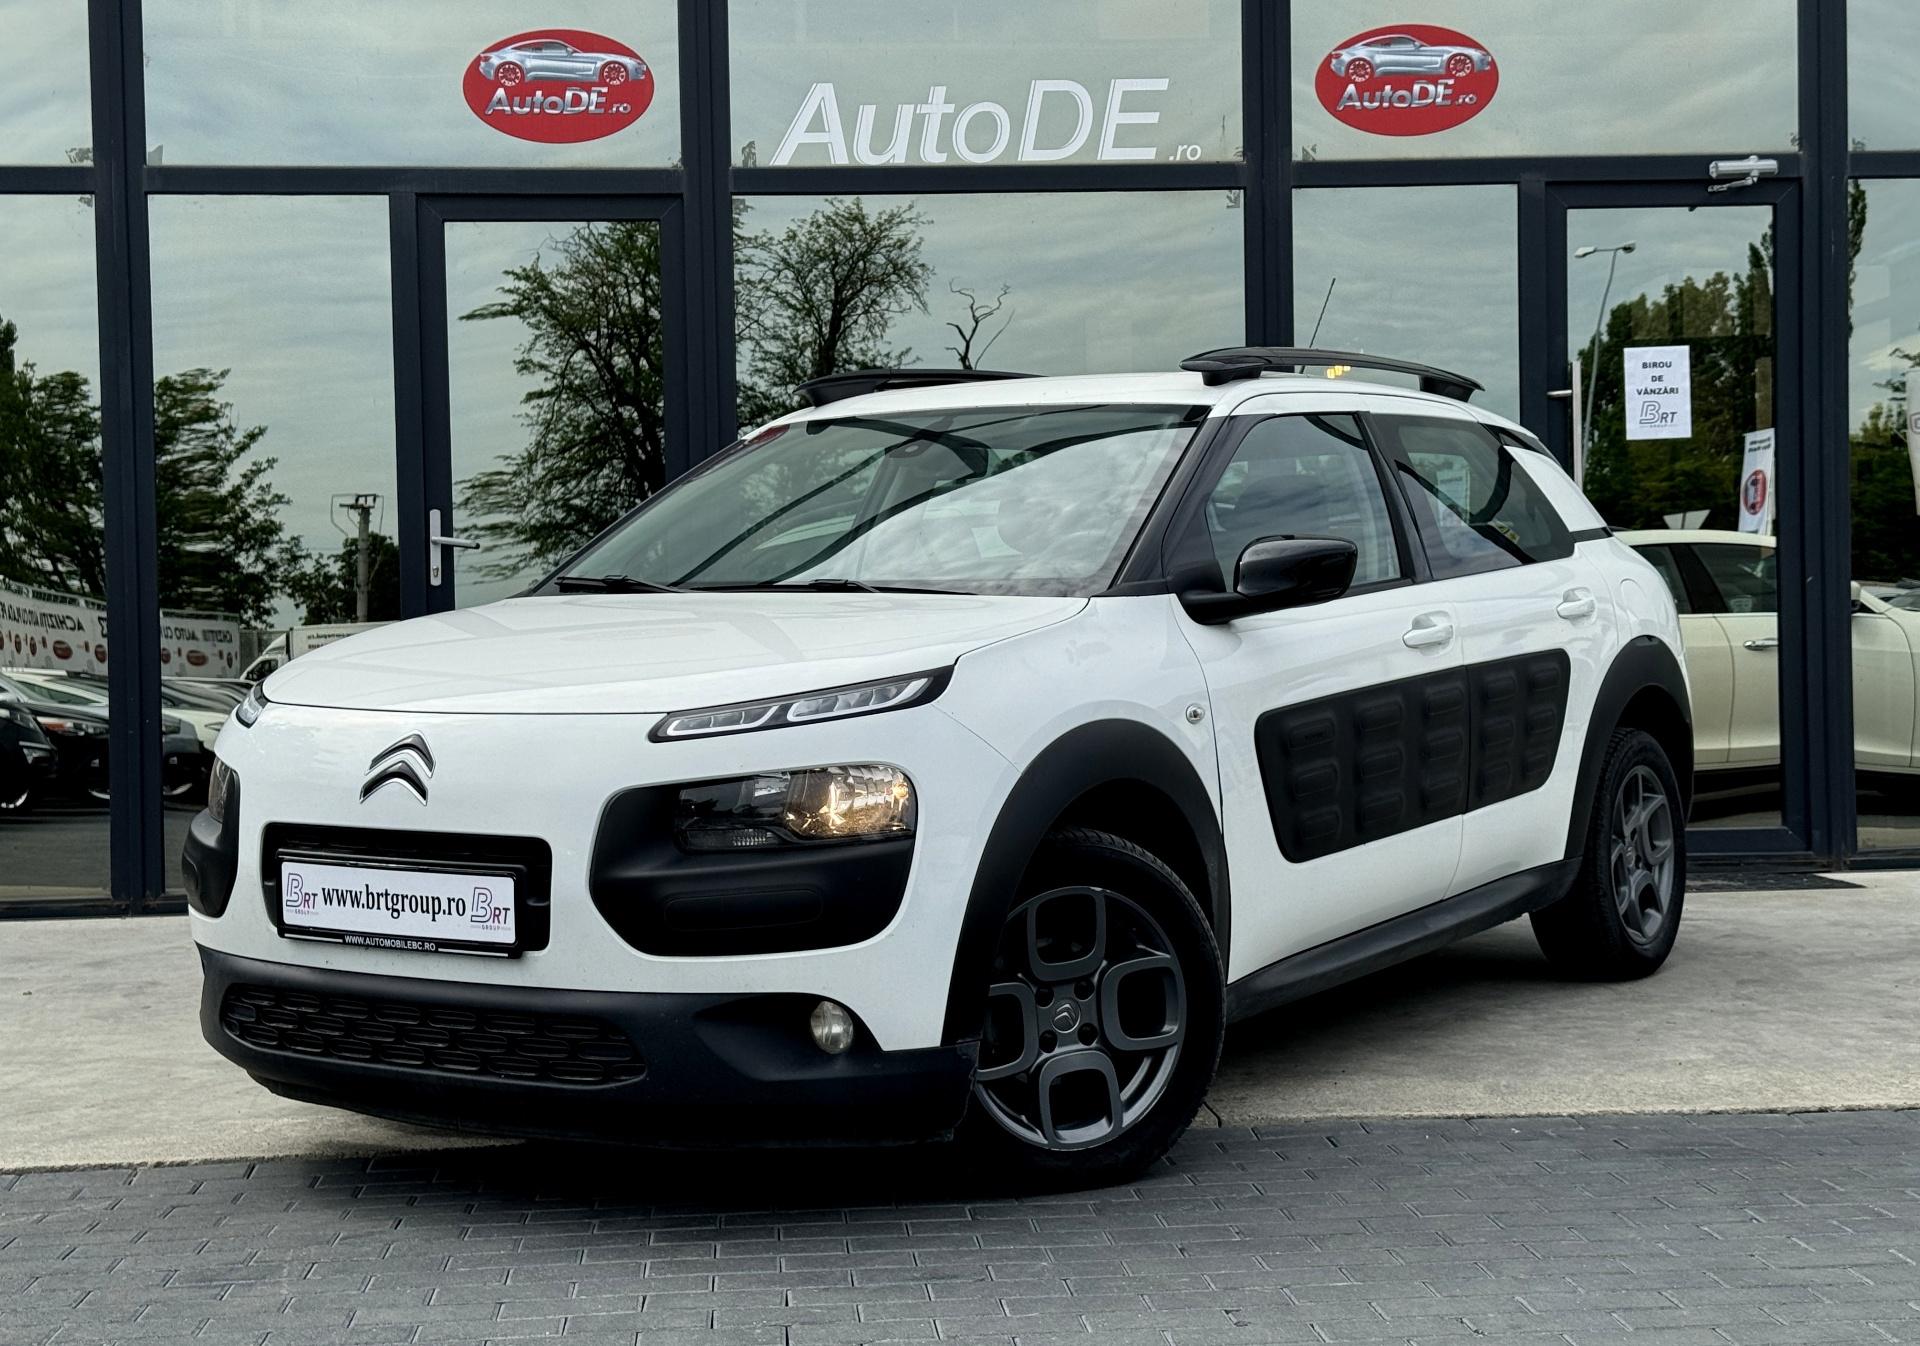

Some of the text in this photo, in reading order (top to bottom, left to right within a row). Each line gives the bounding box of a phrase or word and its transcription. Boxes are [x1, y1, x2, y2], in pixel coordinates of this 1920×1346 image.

[1641, 361, 1672, 369] BIROU
[321, 884, 466, 922] www.brtgroup.ro
[344, 935, 436, 951] WWW.AUTOMOBILEBC.RO
